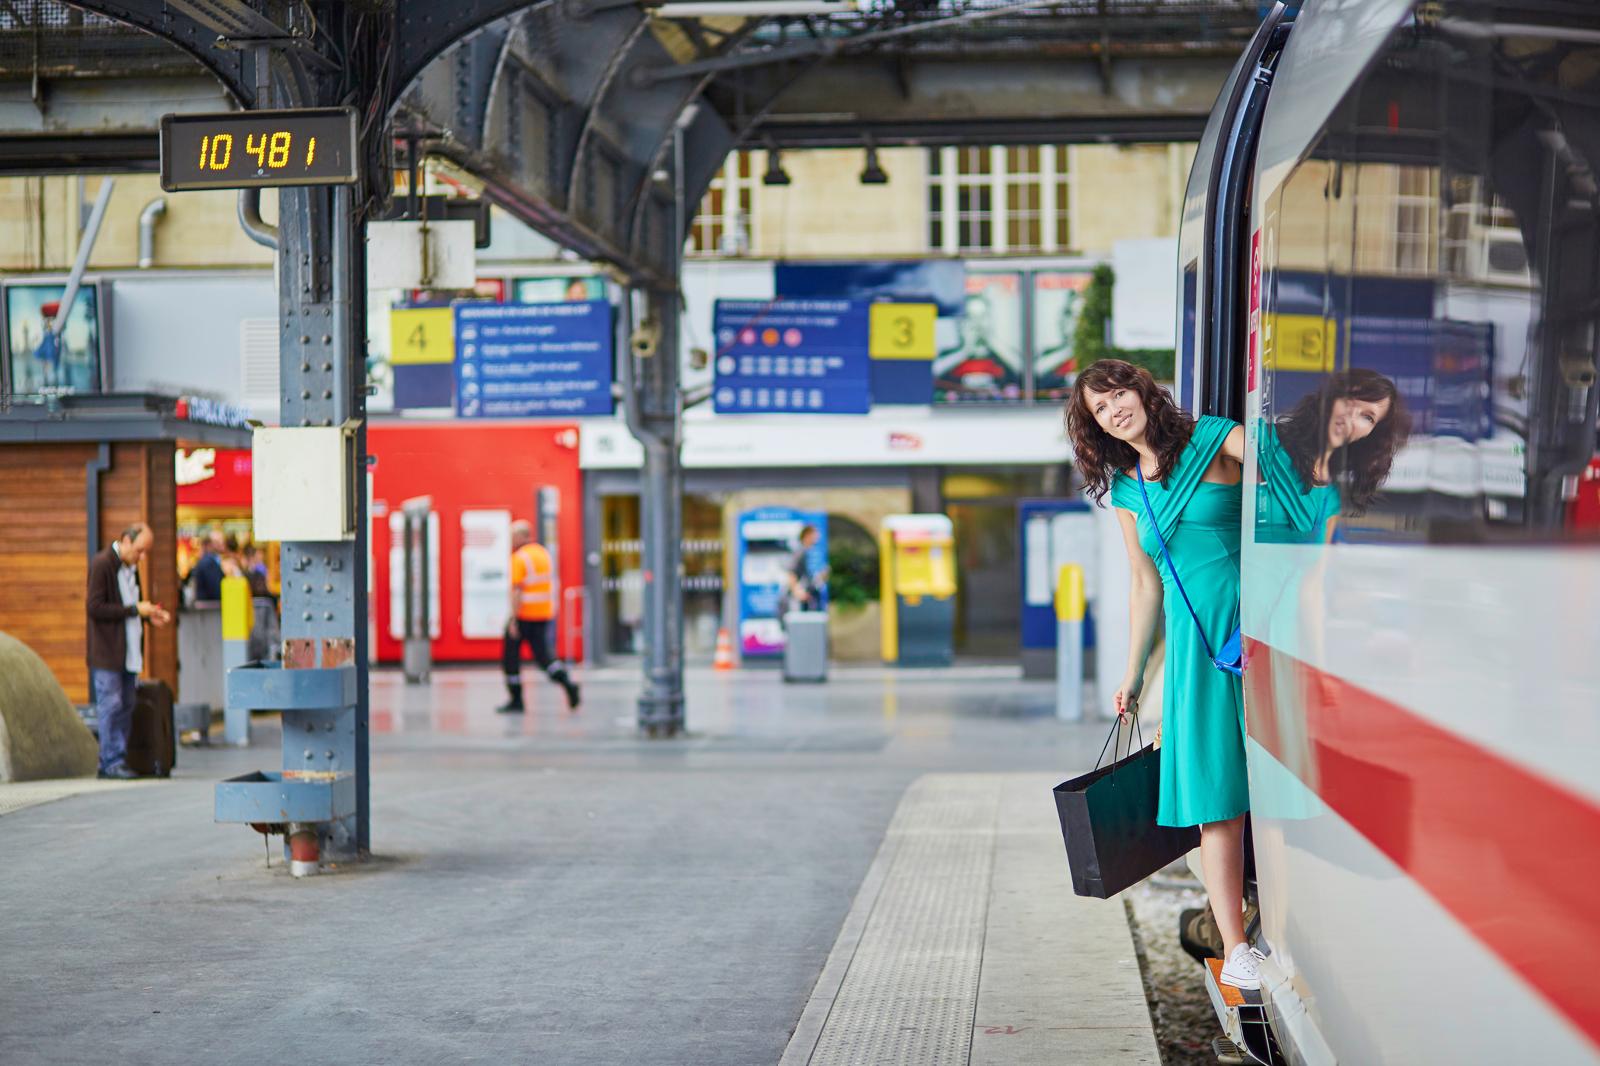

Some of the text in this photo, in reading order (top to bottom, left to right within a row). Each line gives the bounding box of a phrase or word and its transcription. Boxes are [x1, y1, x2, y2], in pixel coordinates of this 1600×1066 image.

[199, 131, 316, 170] 10 48 1
[406, 321, 429, 351] 4
[891, 315, 915, 349] 3
